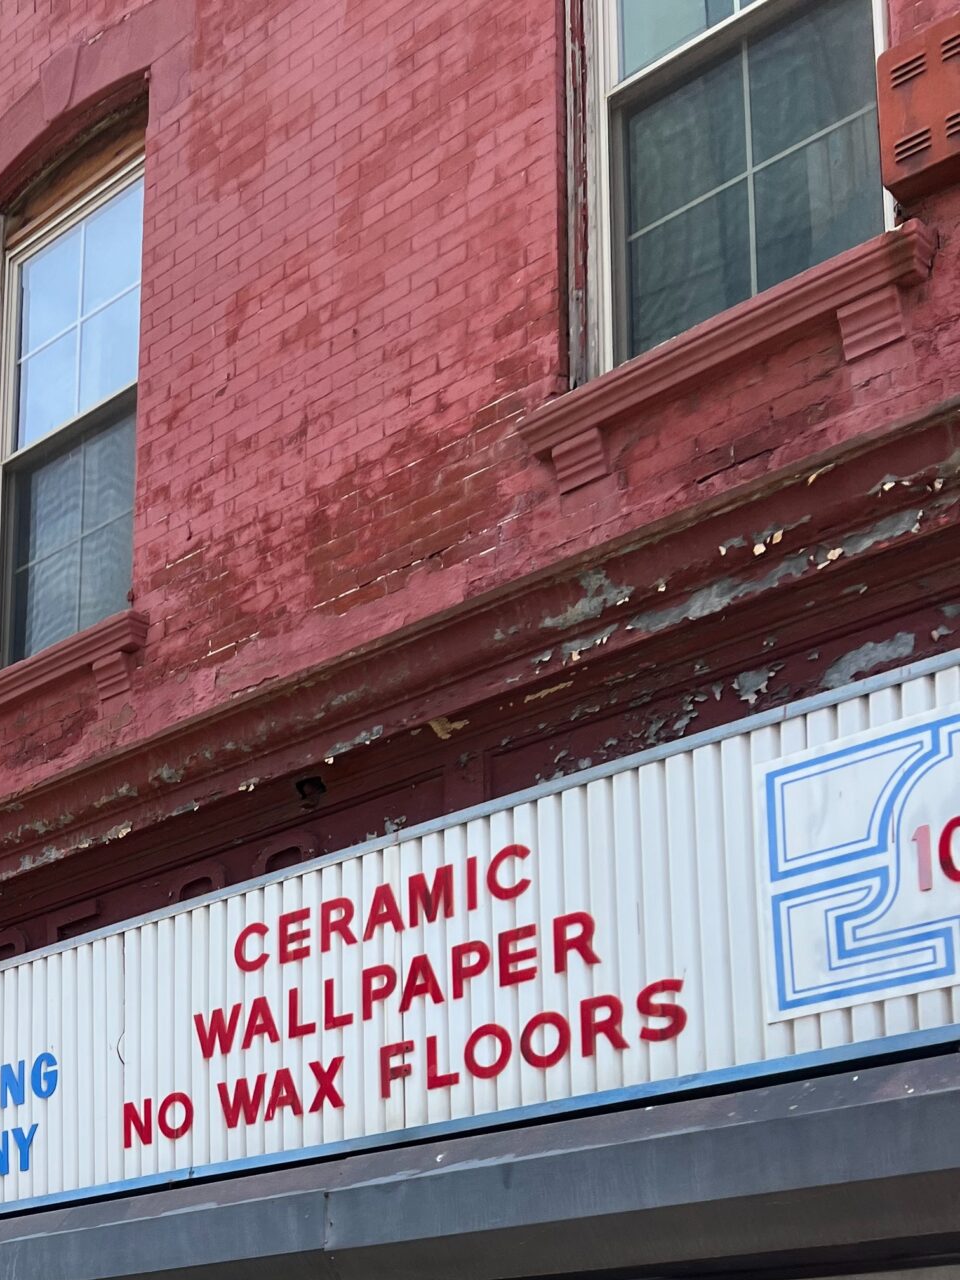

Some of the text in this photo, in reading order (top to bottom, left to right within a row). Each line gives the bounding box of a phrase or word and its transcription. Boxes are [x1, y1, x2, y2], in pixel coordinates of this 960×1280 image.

[234, 843, 532, 973] CERAMIC
[193, 911, 601, 1062] WALLPAPER
[122, 978, 688, 1150] NO WAX FLOORS
